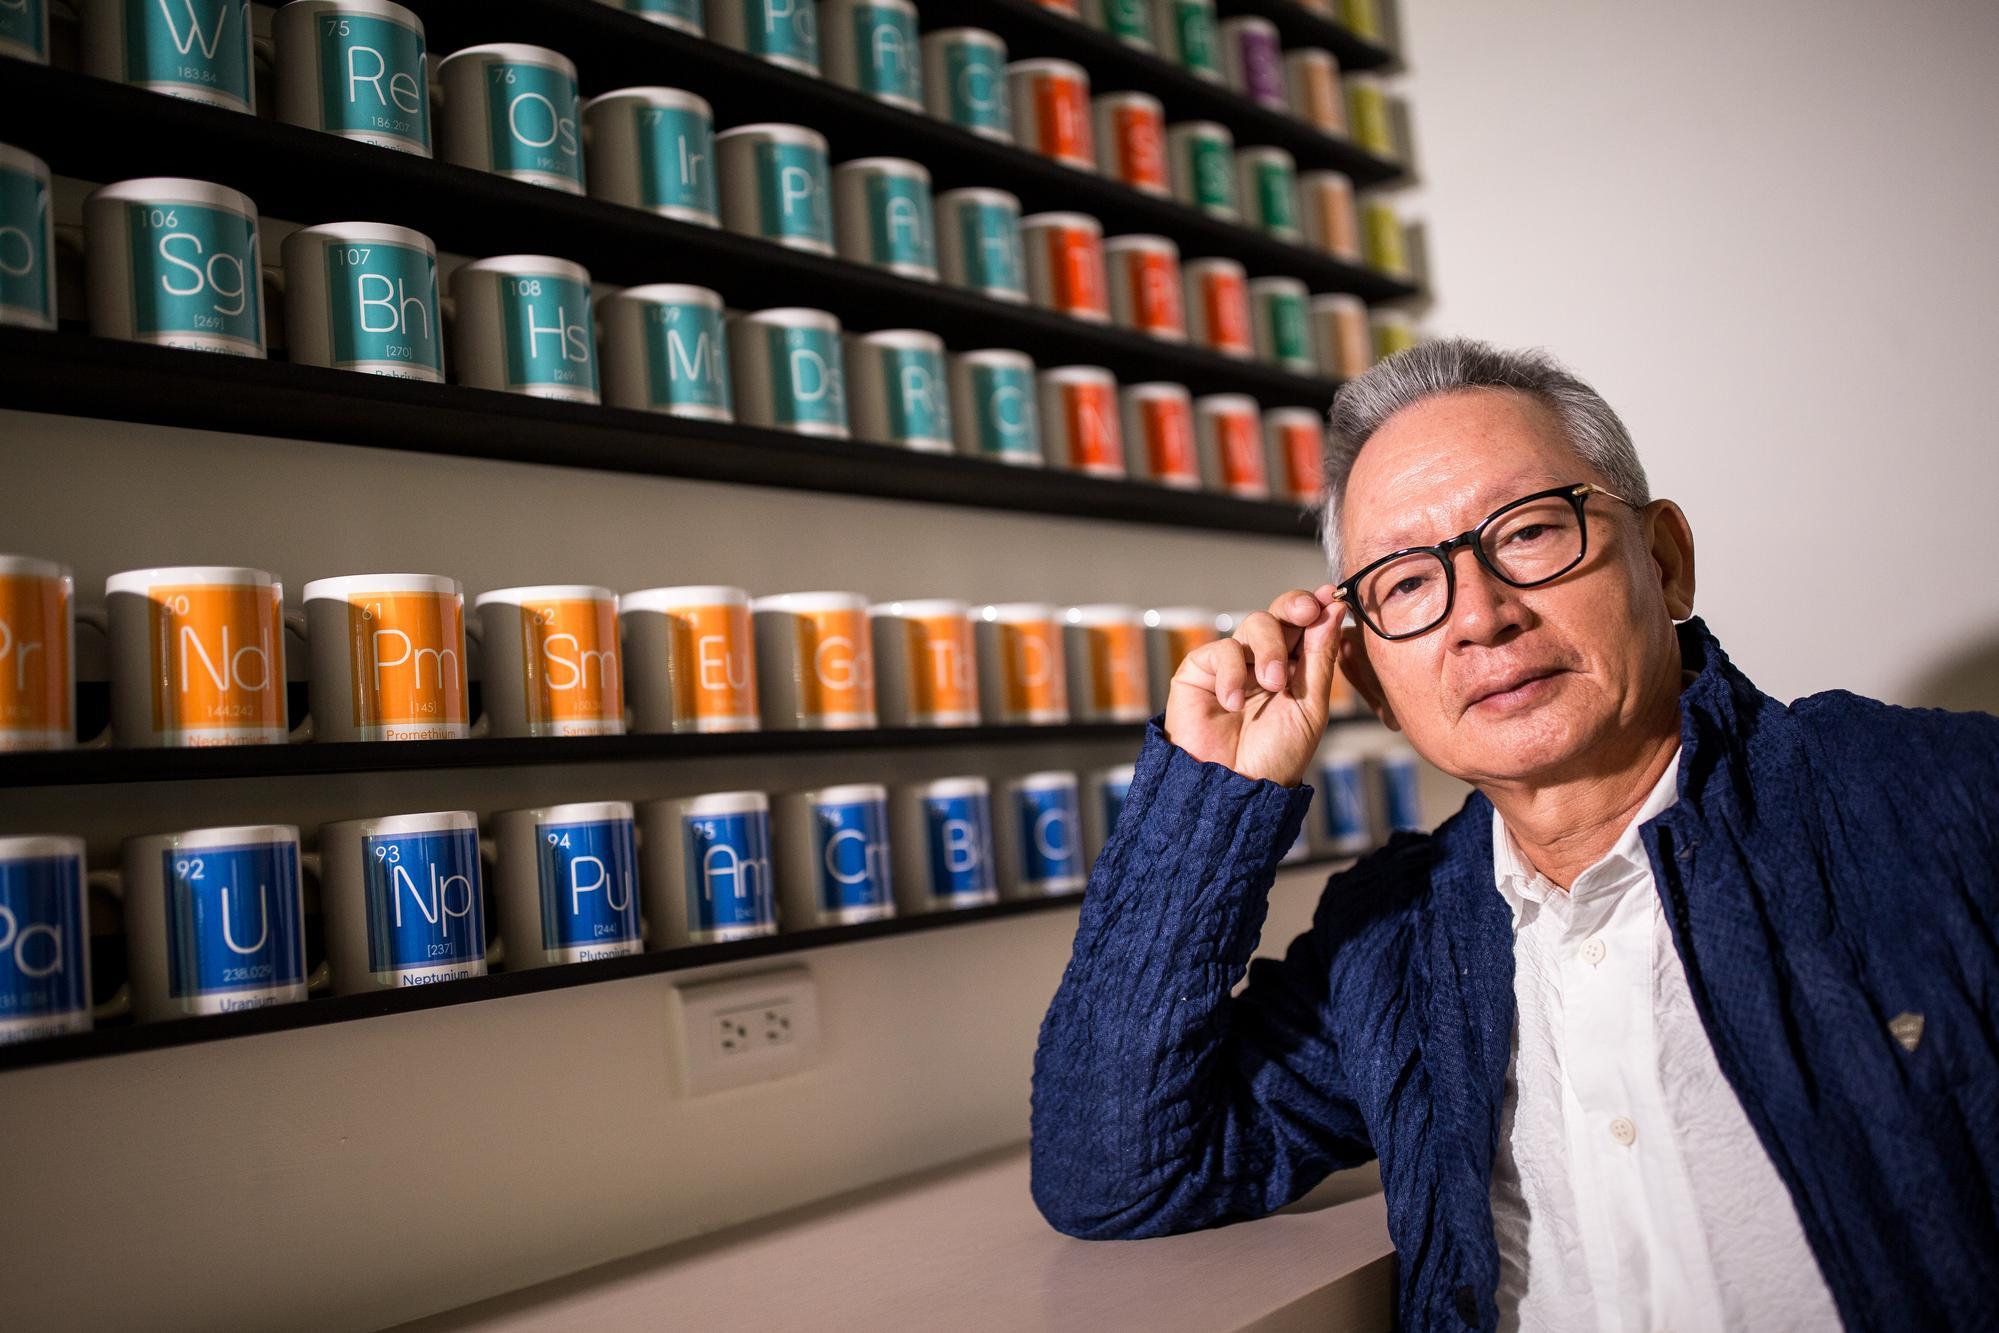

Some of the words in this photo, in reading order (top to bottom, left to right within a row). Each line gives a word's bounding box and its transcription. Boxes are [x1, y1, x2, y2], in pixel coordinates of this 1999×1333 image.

[158, 0, 228, 60] W
[327, 20, 350, 37] 75
[177, 66, 217, 82] 183.84
[348, 45, 419, 114] Re
[493, 68, 516, 84] 76
[371, 116, 410, 132] 186.207
[508, 92, 578, 156] Os
[678, 134, 704, 186] Ir
[781, 166, 824, 217] P
[142, 209, 178, 228] 106
[338, 248, 371, 267] 107
[159, 232, 245, 315] Sg
[510, 279, 541, 297] 108
[357, 273, 428, 340] Bh
[527, 303, 589, 363] Hs
[385, 344, 412, 359] [270]
[163, 595, 190, 616] 60
[361, 602, 384, 622] 61
[532, 607, 556, 626] 62
[180, 624, 270, 693] Nd
[372, 629, 459, 691] Pm
[543, 633, 618, 690] Sm
[699, 635, 750, 690] Eu
[410, 700, 437, 714] [145]
[386, 727, 456, 742] Promethium
[547, 832, 572, 850] 94
[375, 845, 400, 864] 93
[175, 858, 205, 880] 92
[570, 855, 631, 917] Pu
[393, 862, 473, 938] Np
[221, 883, 269, 955] U
[427, 941, 453, 958] [237]
[402, 969, 469, 986] Neptunium
